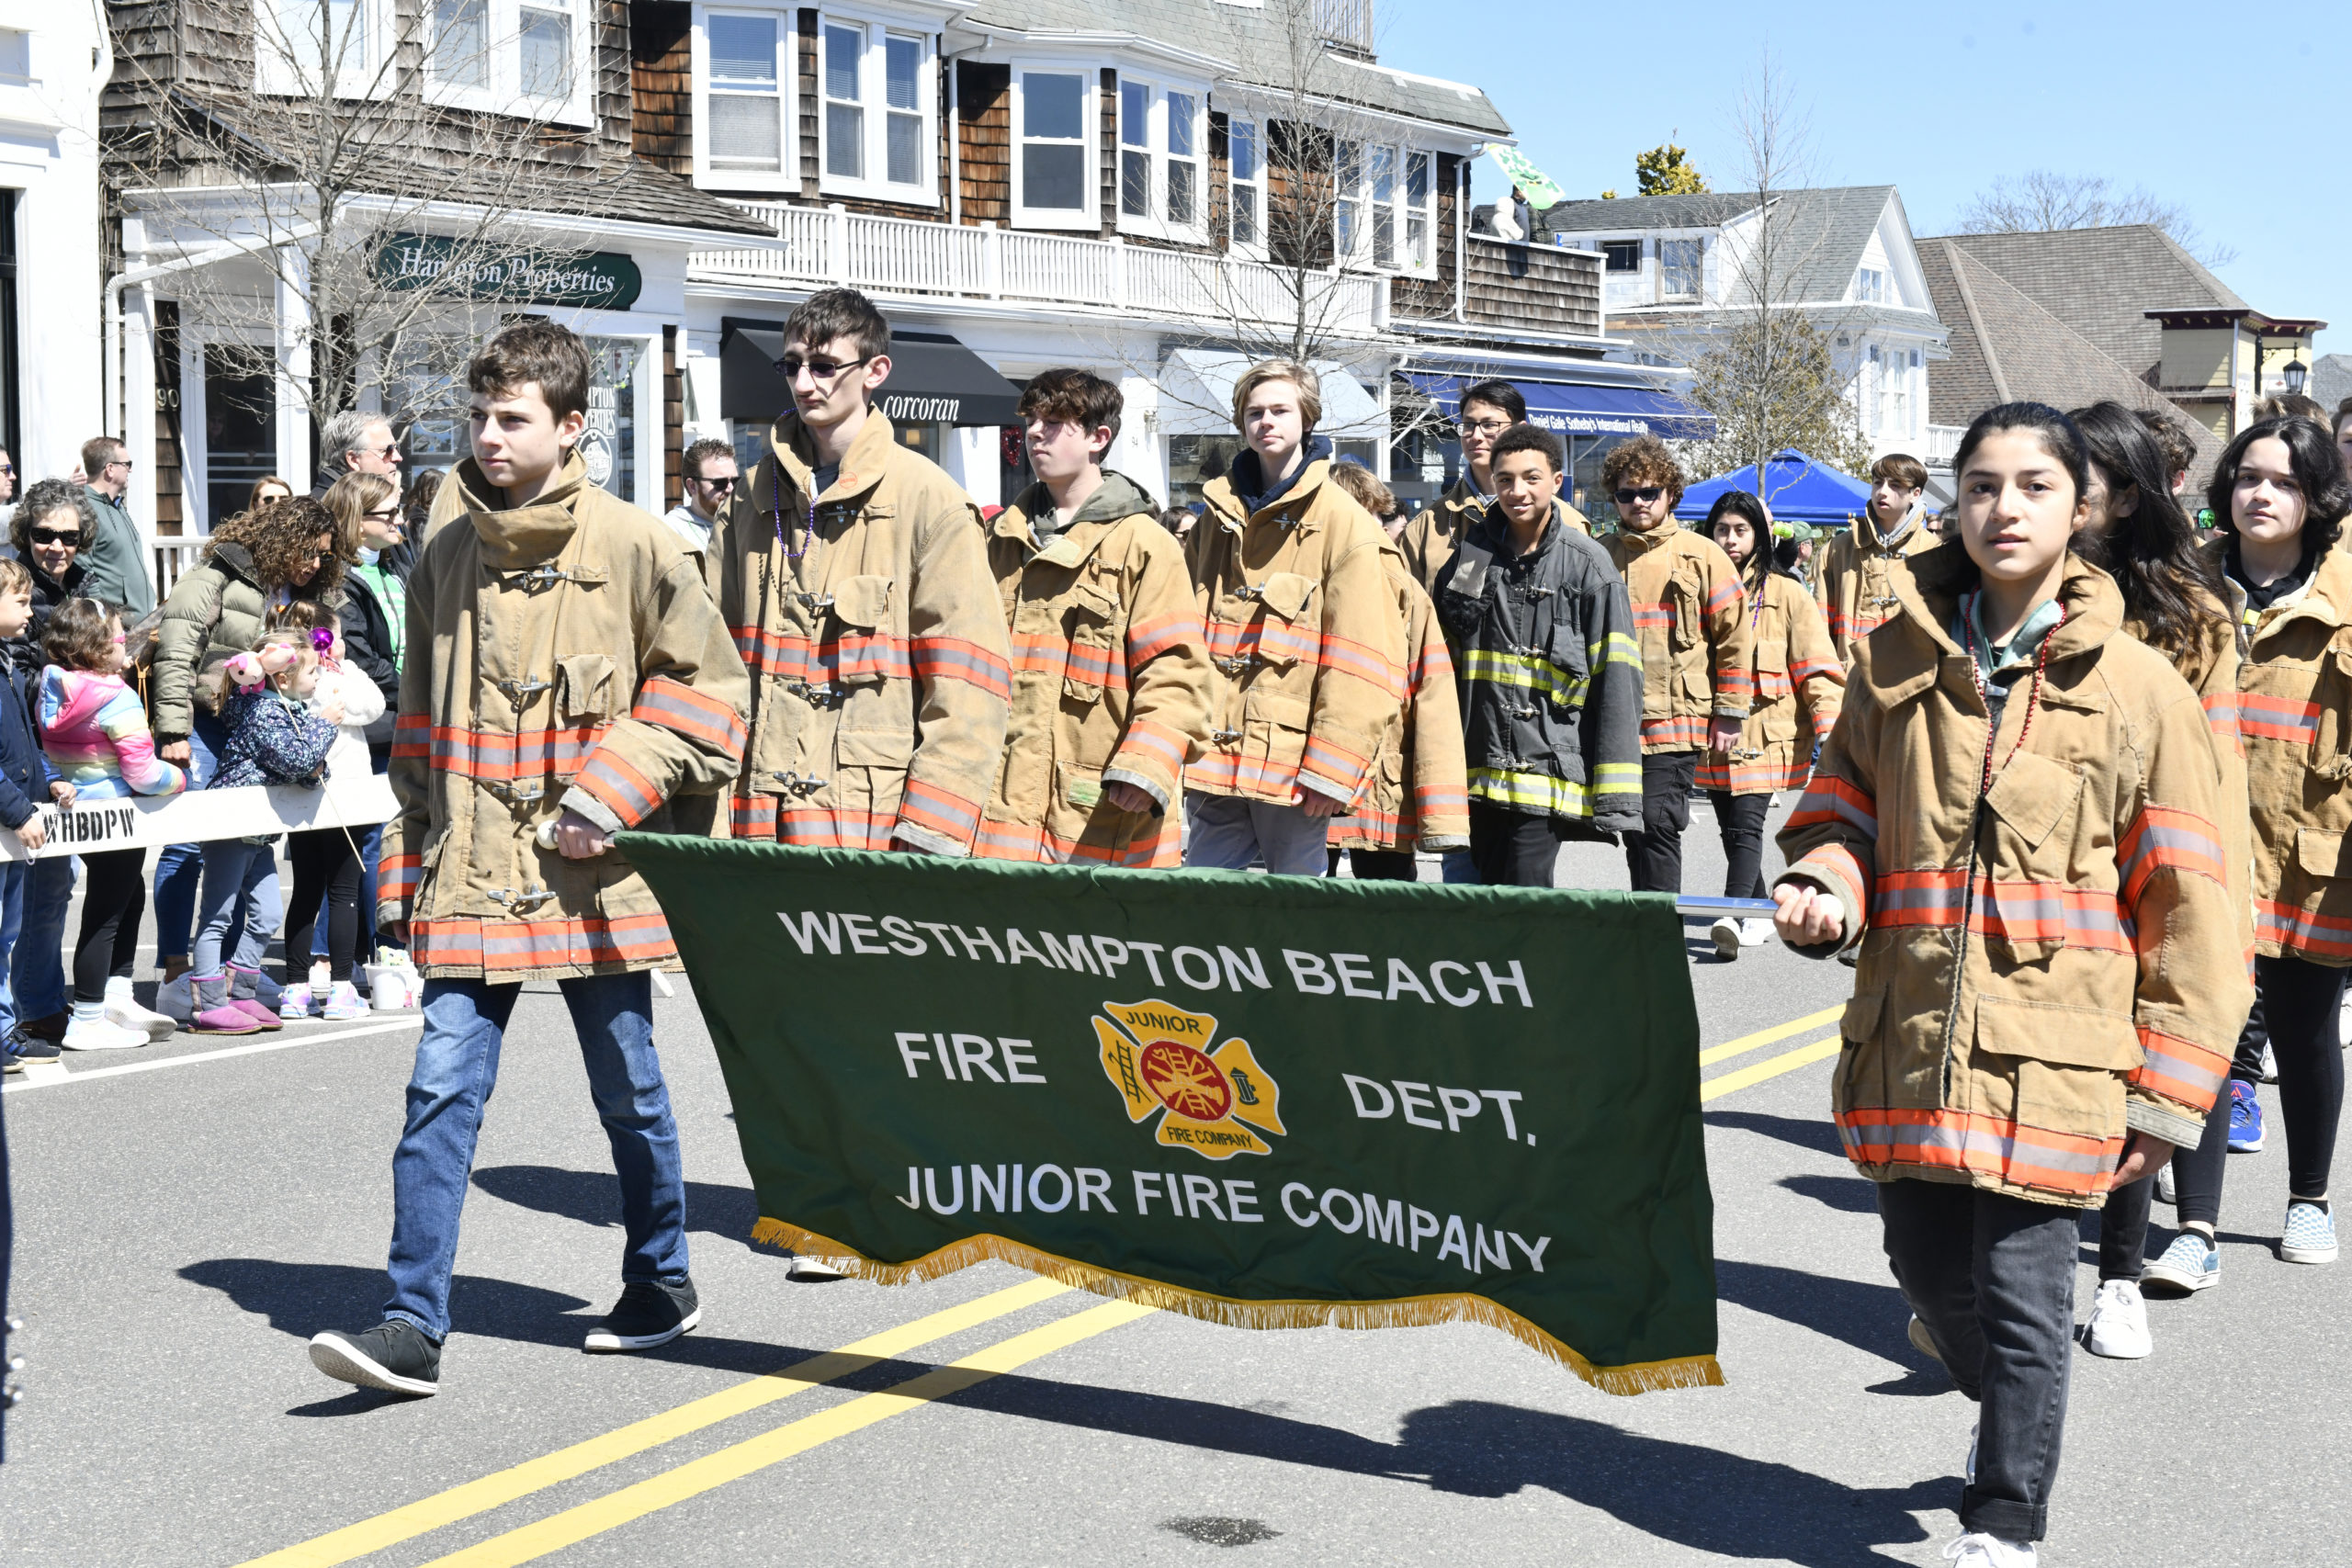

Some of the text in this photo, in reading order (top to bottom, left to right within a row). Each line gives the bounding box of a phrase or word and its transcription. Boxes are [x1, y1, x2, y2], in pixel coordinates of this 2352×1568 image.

[509, 256, 616, 294] Properties
[157, 388, 179, 408] 90
[883, 395, 959, 422] corcoran
[1528, 413, 1648, 436] Daniel Gale Sotheby's International Realty
[43, 807, 134, 843] WHBDPW
[777, 910, 1533, 1008] WESTHAMPTON BEACH
[1125, 1011, 1204, 1035] JUNIOR
[895, 1032, 1536, 1146] FIRE DEPT.
[1166, 1126, 1253, 1148] FIRE COMPANY
[896, 1163, 1552, 1274] JUNIOR FIRE COMPANY
